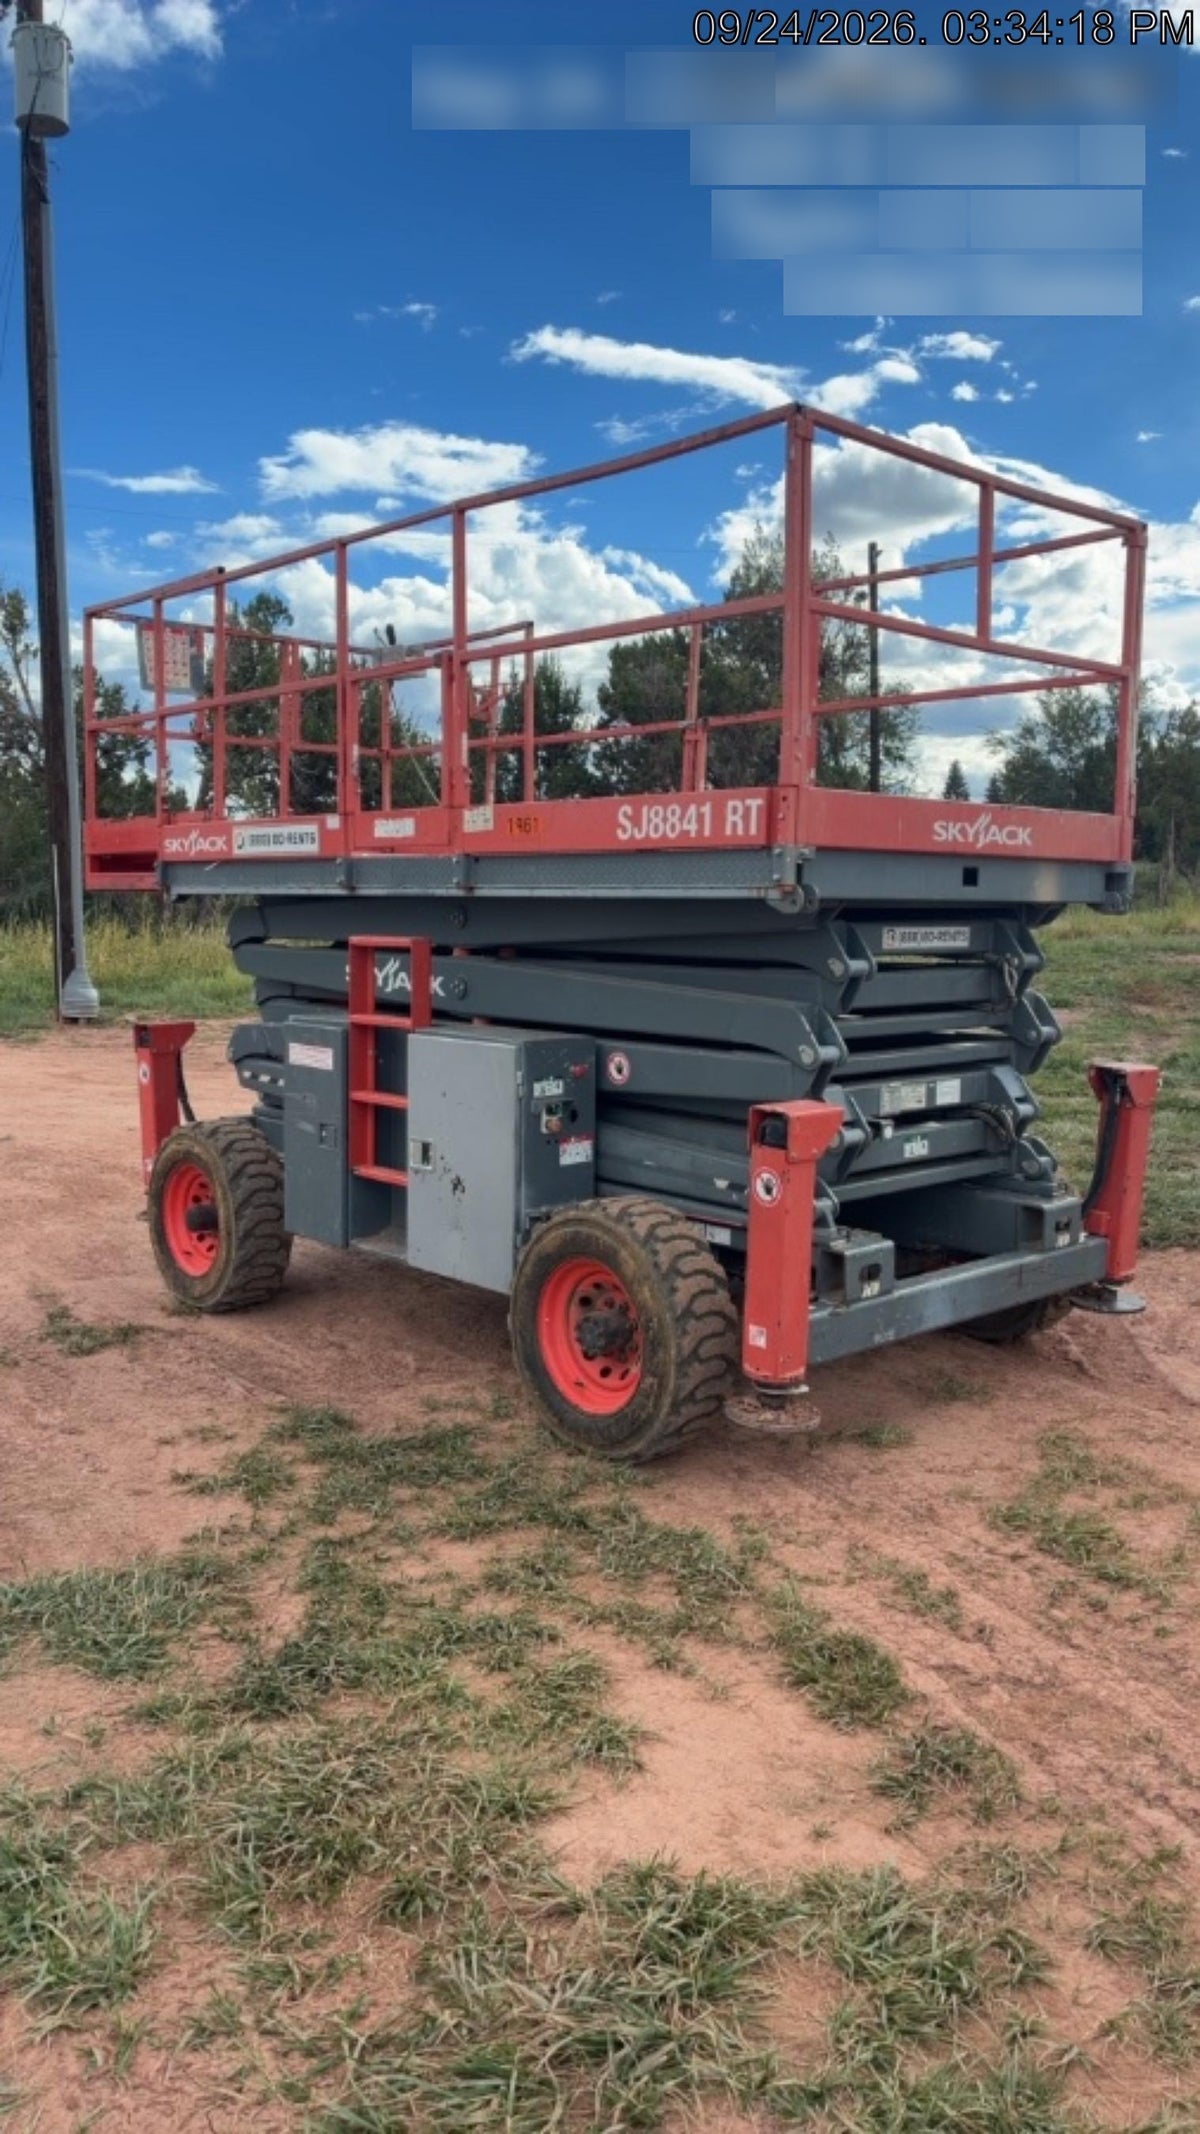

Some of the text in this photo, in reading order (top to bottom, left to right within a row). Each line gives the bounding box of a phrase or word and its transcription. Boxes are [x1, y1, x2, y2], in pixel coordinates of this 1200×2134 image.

[616, 798, 764, 841] SJ8841 RT
[932, 811, 1033, 850] SKYJACK
[163, 829, 228, 856] SKYJACK
